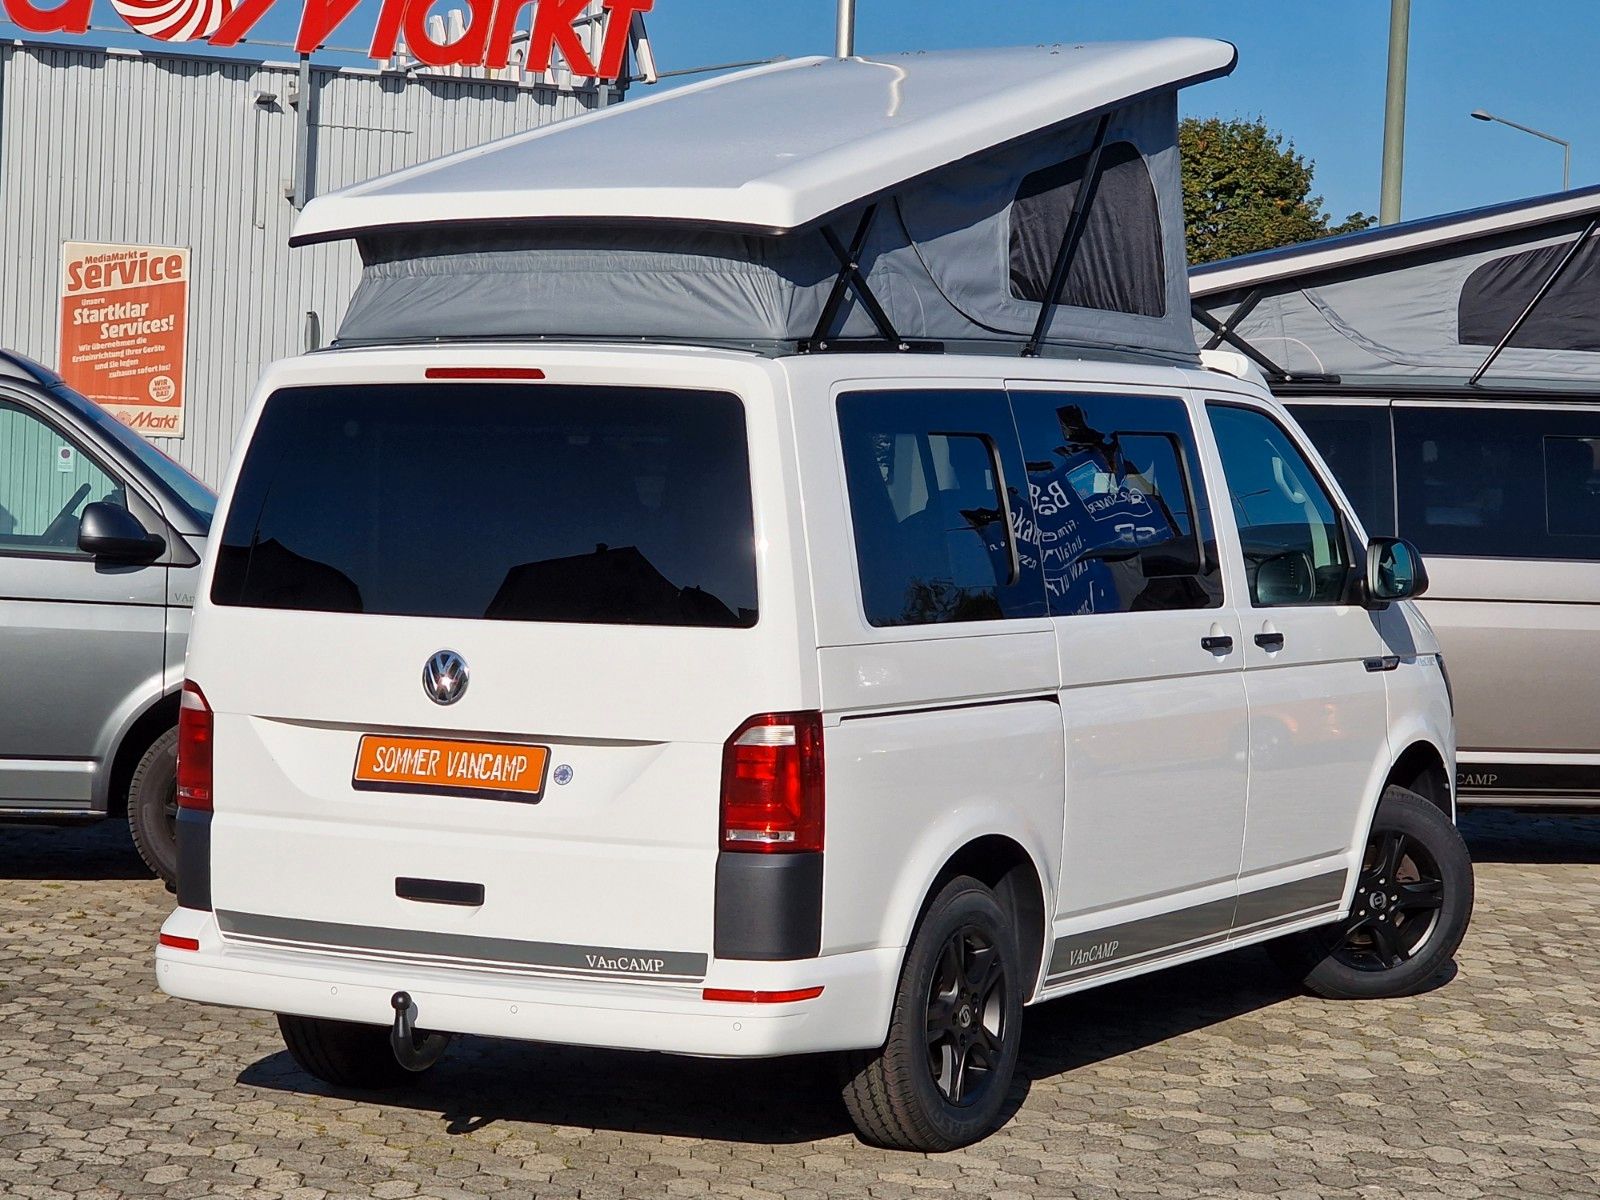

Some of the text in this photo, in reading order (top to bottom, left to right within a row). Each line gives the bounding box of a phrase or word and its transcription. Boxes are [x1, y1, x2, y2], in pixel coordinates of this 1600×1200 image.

[85, 251, 137, 264] MediaMarkt
[68, 252, 182, 292] Service
[81, 298, 105, 306] Unsere
[73, 302, 149, 325] Startklar
[100, 315, 174, 339] Services!
[79, 336, 147, 352] Wir übernehmen die
[72, 350, 125, 363] Ersteinrichtung
[143, 344, 165, 354] Geräte
[94, 358, 139, 370] und Sie legen
[108, 369, 136, 379] zuhause
[137, 365, 157, 376] sofort
[154, 378, 168, 386] WIR
[128, 411, 178, 428] Markt
[373, 745, 440, 776] SOMMER
[447, 750, 528, 782] VANCAMP
[1070, 940, 1119, 966] VAnCAMP
[586, 953, 665, 973] VAnCAMP
